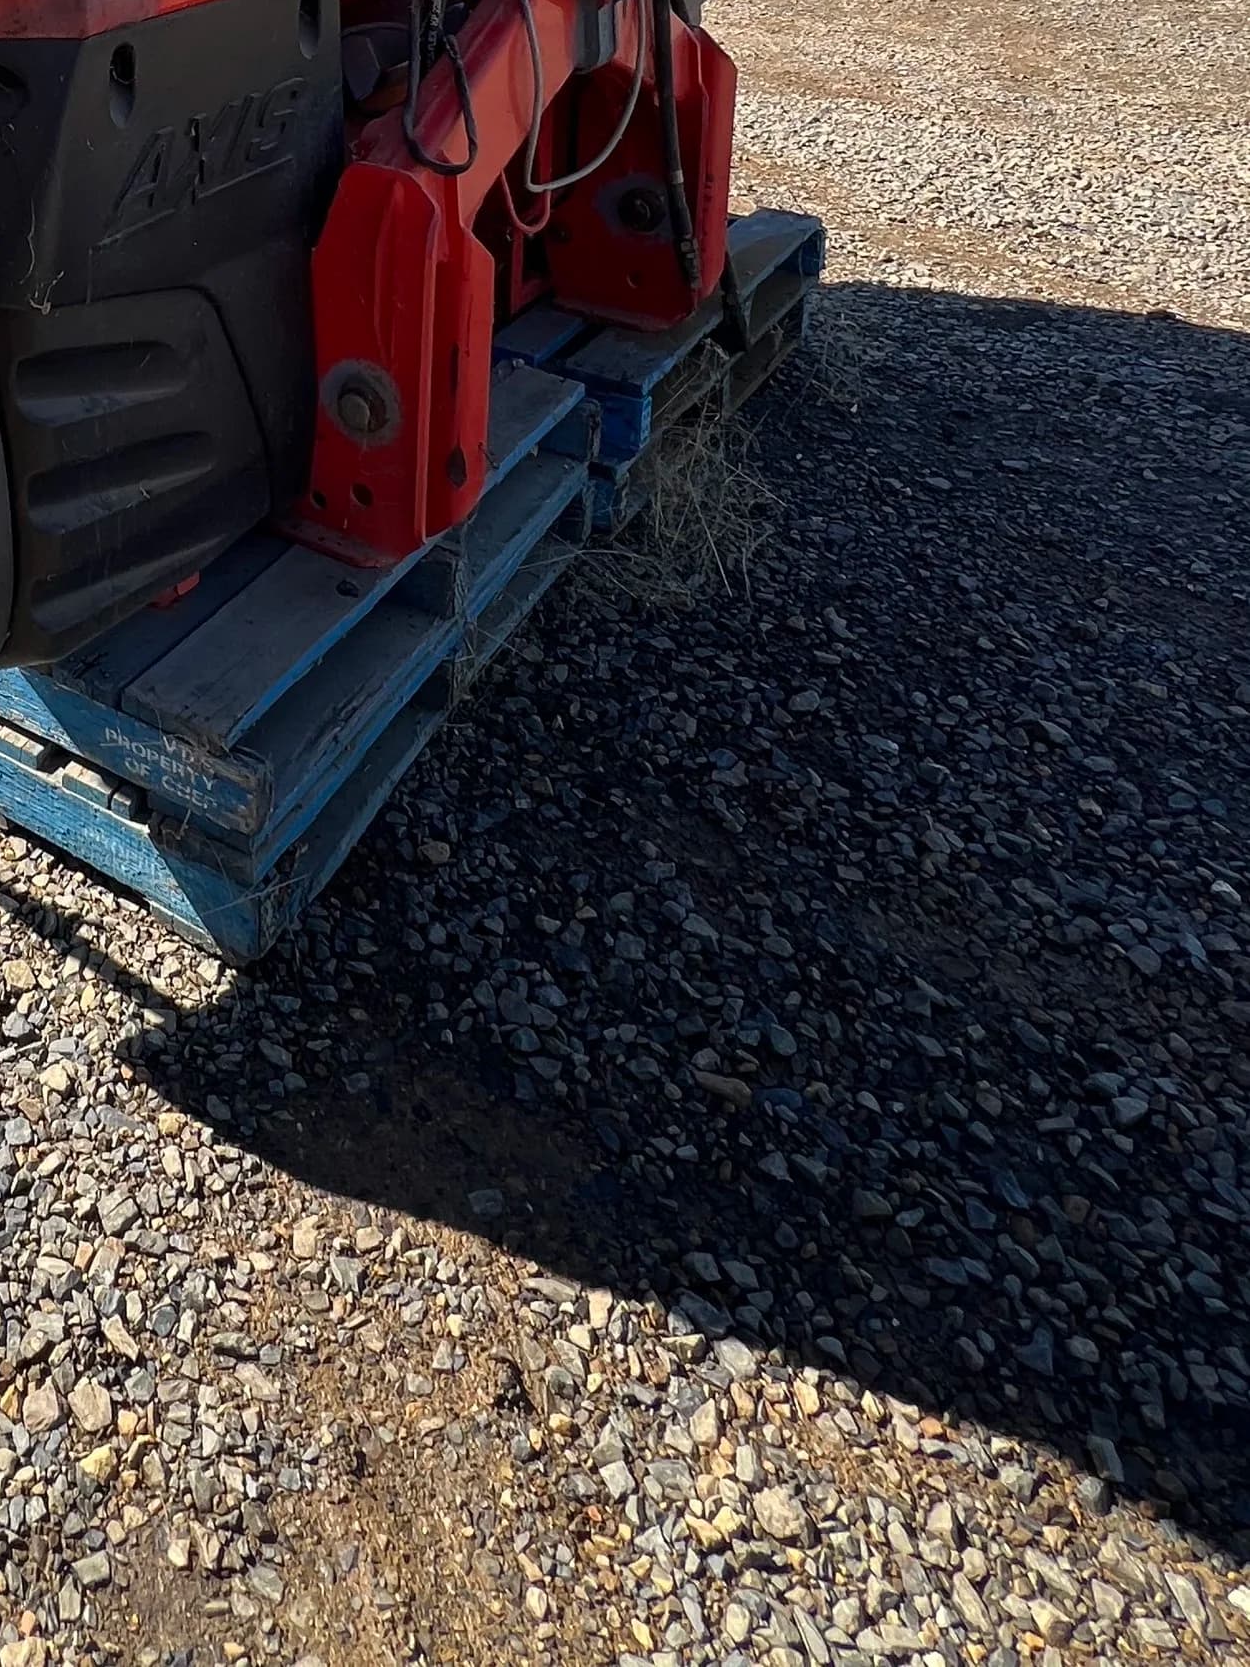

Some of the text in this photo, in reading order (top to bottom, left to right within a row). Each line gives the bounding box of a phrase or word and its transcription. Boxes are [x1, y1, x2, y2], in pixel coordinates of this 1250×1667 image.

[98, 76, 305, 244] AXIS
[105, 726, 220, 791] PROPERTY
[124, 756, 152, 778] OF
